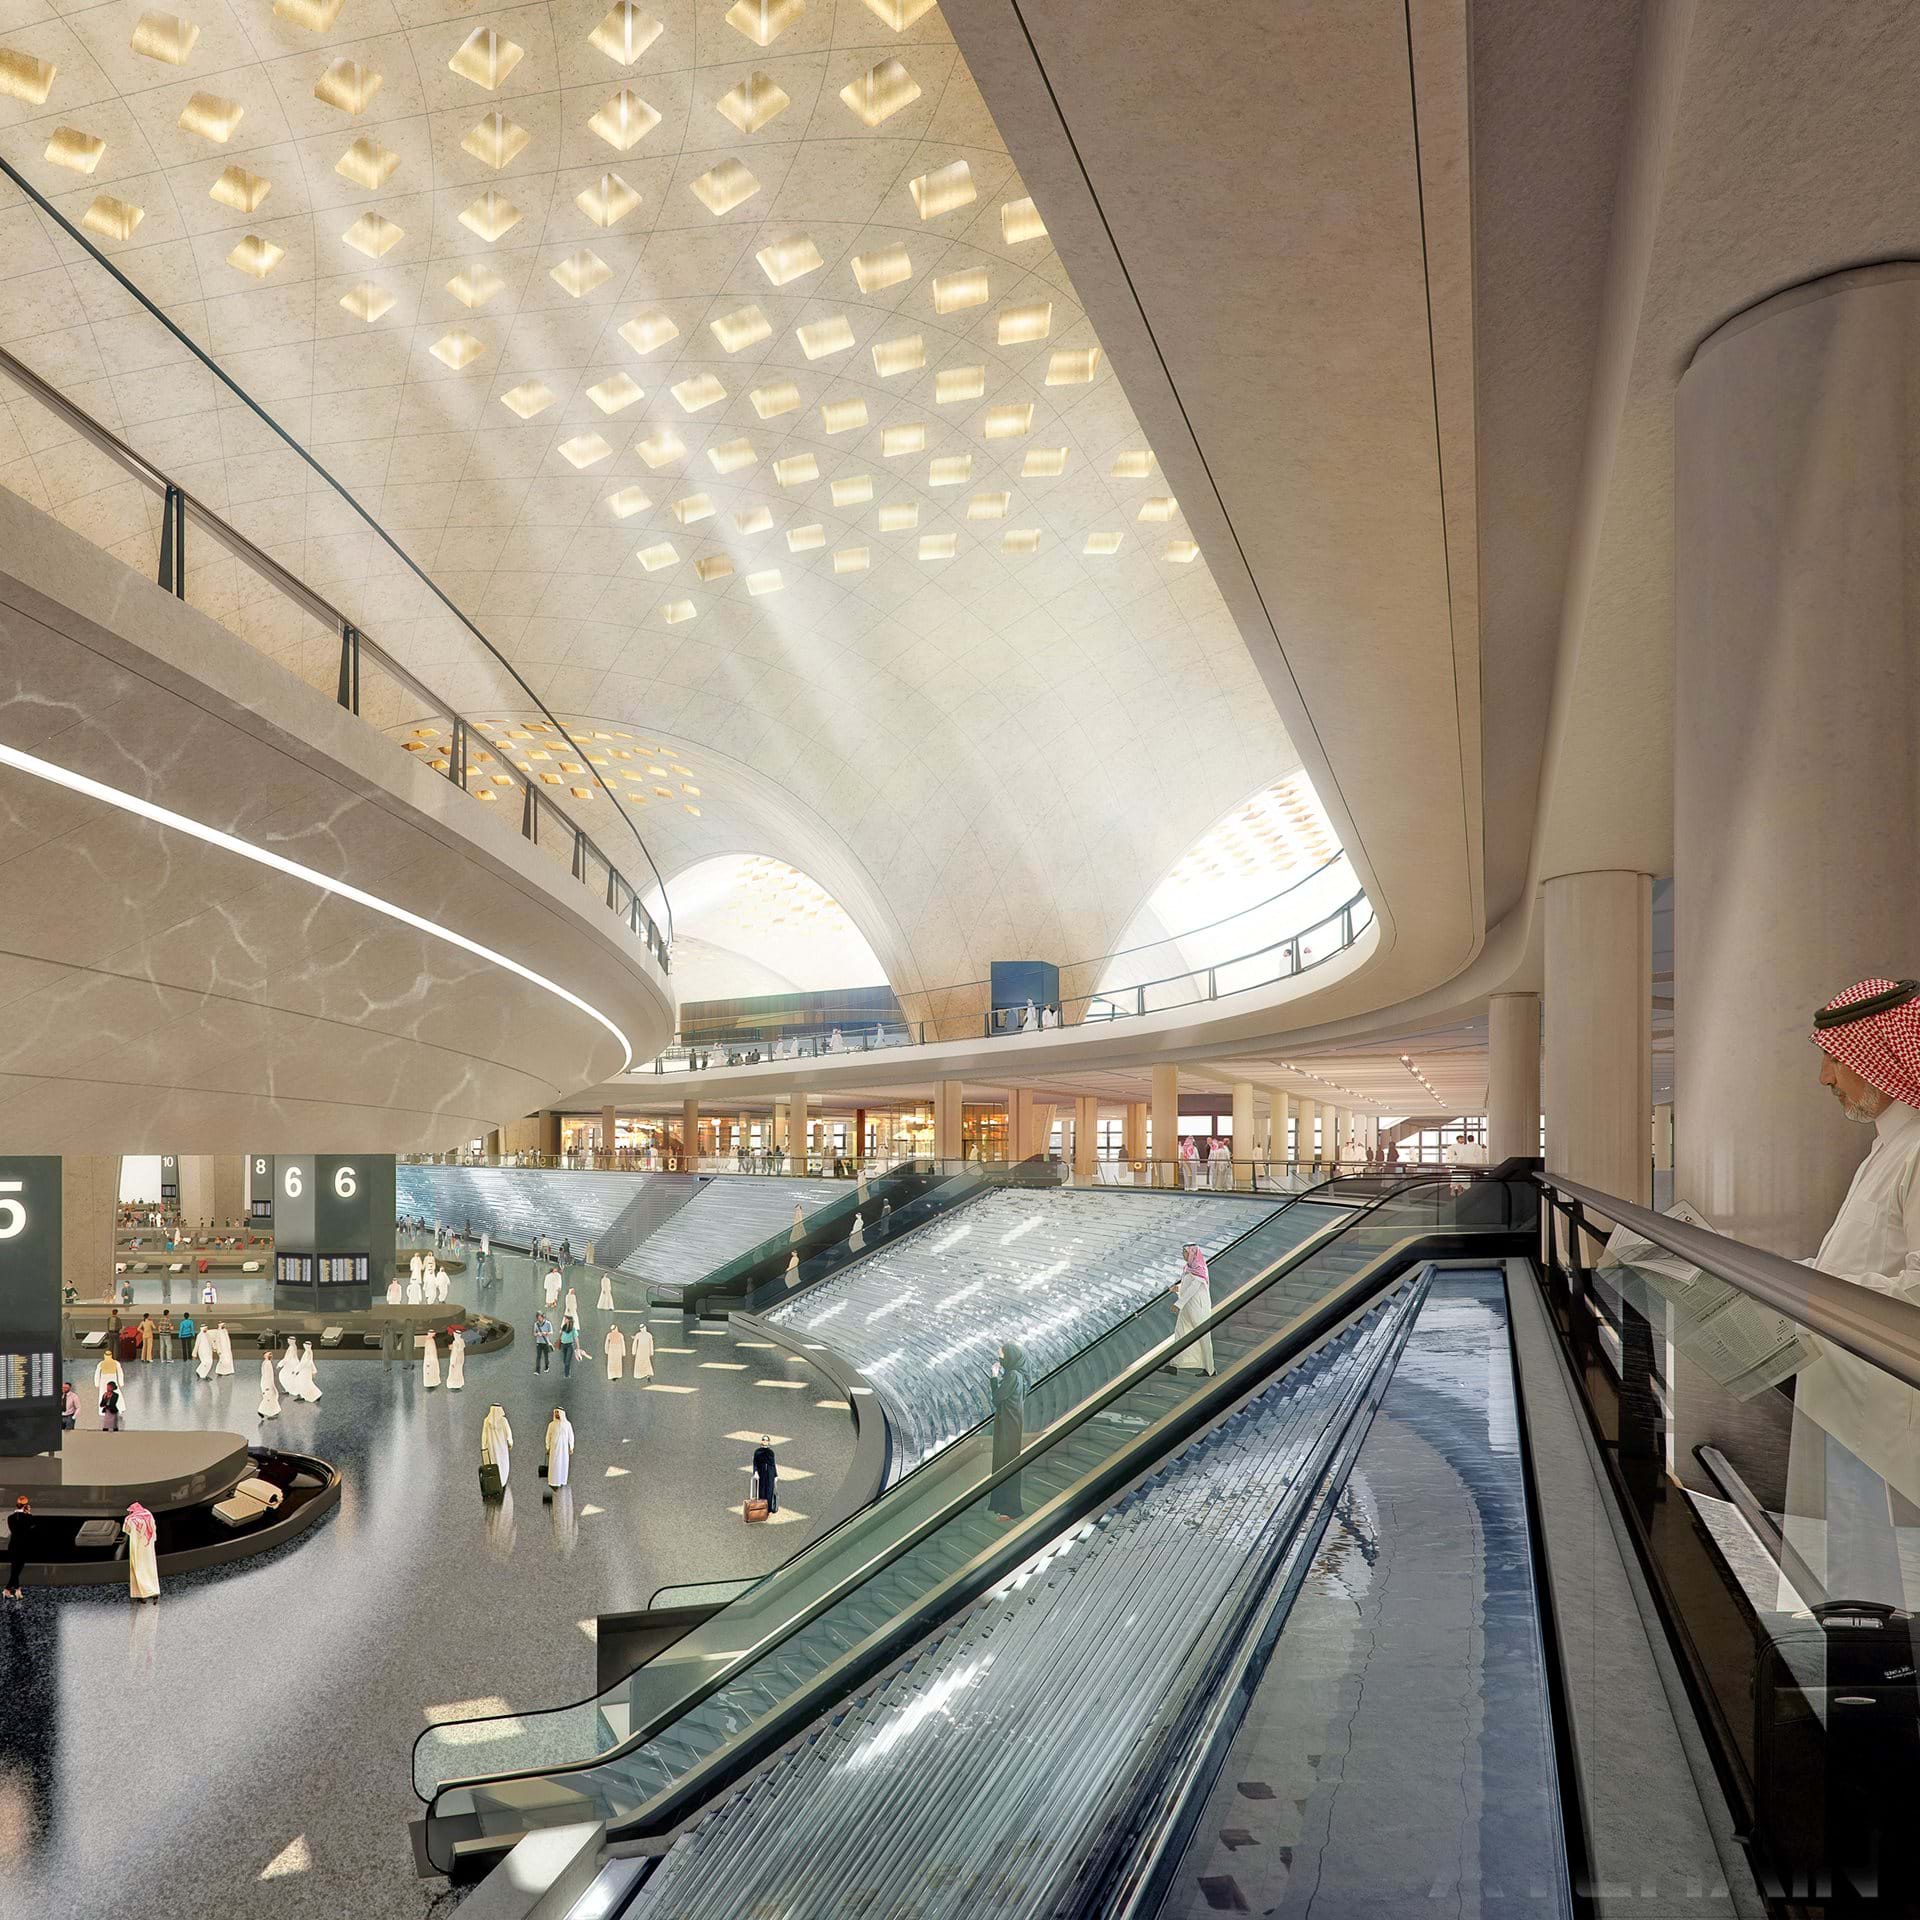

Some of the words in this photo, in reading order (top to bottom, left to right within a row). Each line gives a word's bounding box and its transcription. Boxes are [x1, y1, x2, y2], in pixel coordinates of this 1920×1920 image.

[163, 1157, 173, 1167] 10
[256, 1159, 266, 1174] 8
[668, 1157, 678, 1171] 8
[285, 1167, 302, 1197] 6
[335, 1167, 356, 1197] 6
[0, 1181, 26, 1239] 5
